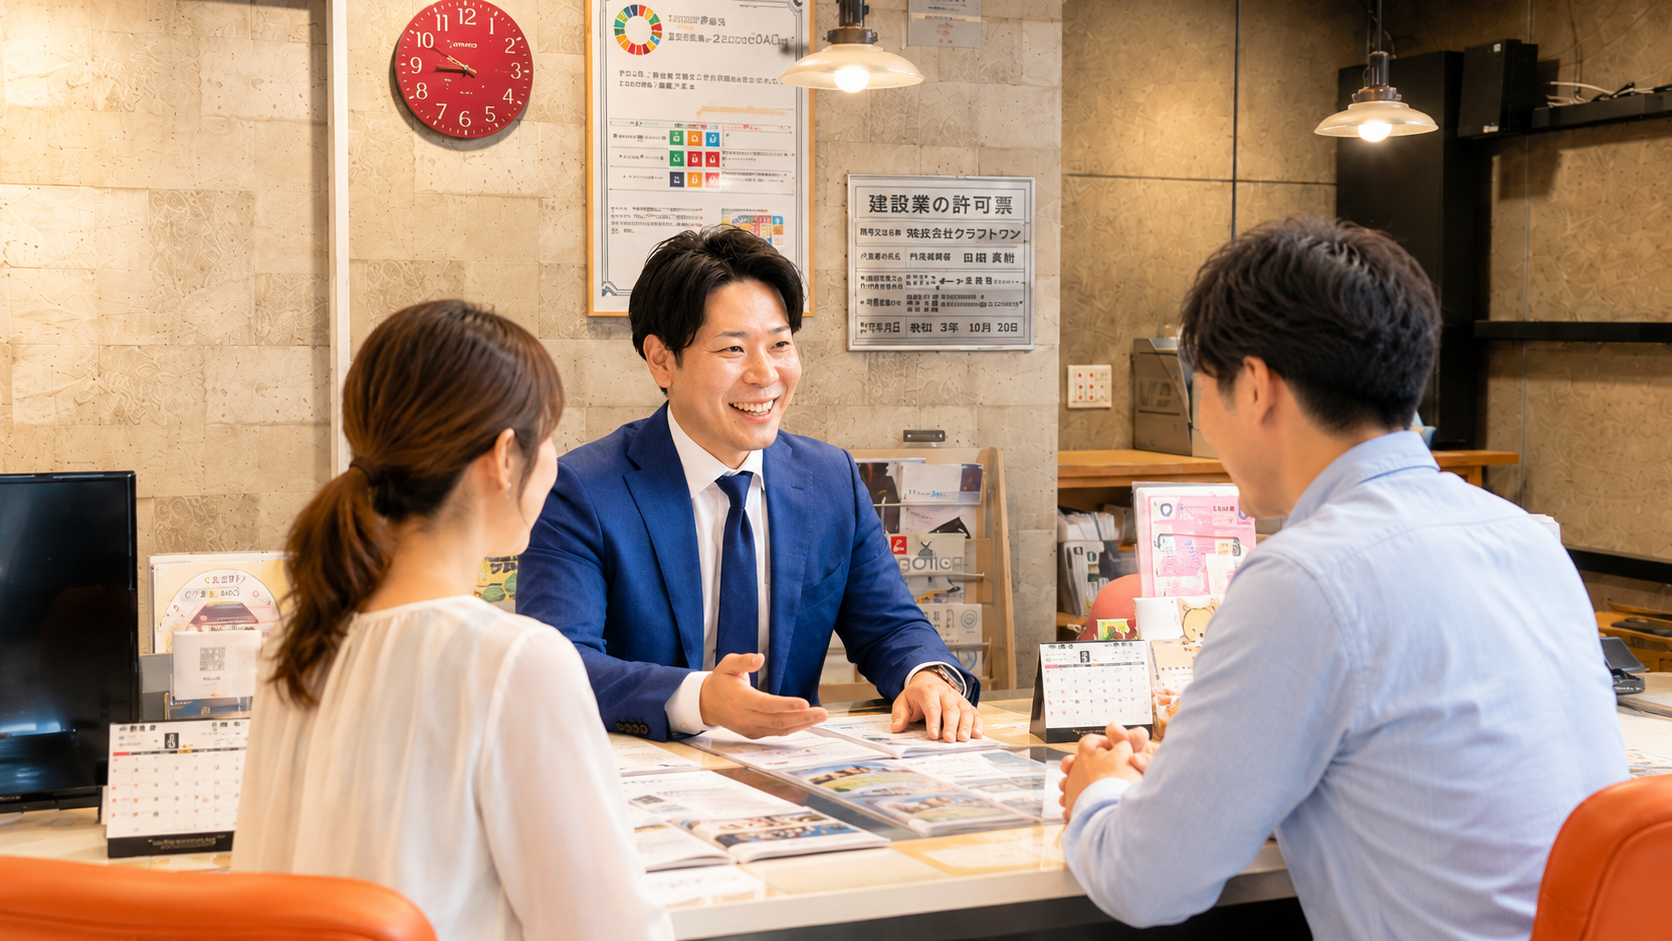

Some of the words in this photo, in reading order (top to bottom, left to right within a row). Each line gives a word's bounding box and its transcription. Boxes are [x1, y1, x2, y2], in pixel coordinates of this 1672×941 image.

[436, 14, 448, 31] 11
[458, 8, 476, 25] 12
[489, 17, 494, 34] 1
[416, 32, 434, 48] 10
[505, 38, 516, 54] 2
[410, 57, 422, 74] 9
[510, 63, 521, 79] 3
[416, 82, 428, 99] 8
[502, 88, 514, 104] 4
[436, 103, 447, 120] 7
[459, 111, 471, 127] 6
[485, 106, 496, 122] 5
[869, 194, 1013, 215] 建設業の許可票
